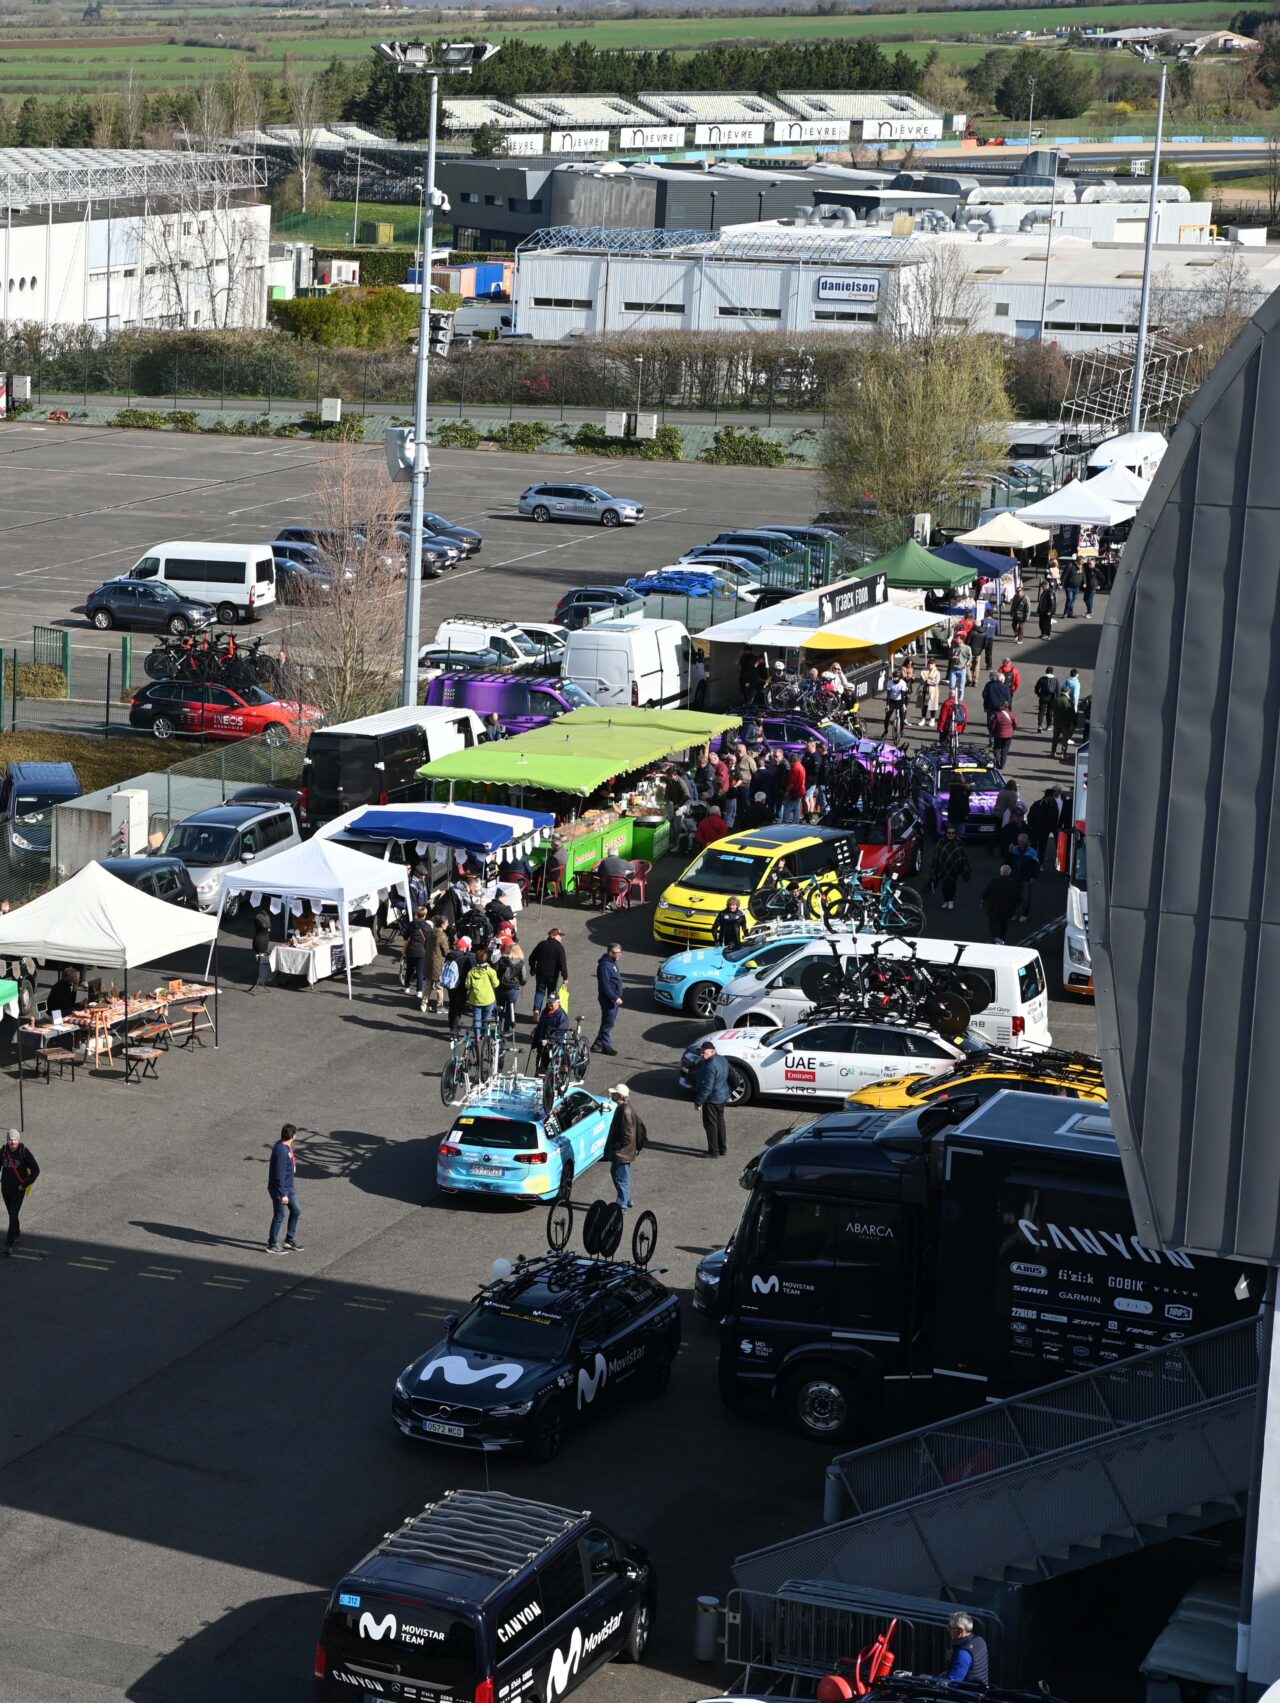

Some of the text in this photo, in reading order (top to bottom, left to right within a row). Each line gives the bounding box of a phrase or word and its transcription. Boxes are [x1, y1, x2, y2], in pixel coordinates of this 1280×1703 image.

[821, 280, 875, 293] danielson
[213, 714, 244, 726] INEOS
[784, 1056, 816, 1070] UAE
[785, 1085, 817, 1094] XRG
[845, 1222, 894, 1238] ABARCA
[1018, 1219, 1196, 1269] CANYON
[783, 1282, 815, 1291] MOVISTAR
[783, 1287, 801, 1295] TEAM
[1108, 1276, 1144, 1292] GOBIK
[1059, 1291, 1101, 1304] GARMIN
[608, 1344, 646, 1377] Movistar
[426, 1422, 446, 1433] 0572
[497, 1601, 542, 1643] CANYON
[401, 1633, 425, 1646] TEAM
[402, 1624, 445, 1641] MOVISTAR
[583, 1611, 624, 1658] Movistar
[332, 1670, 384, 1692] CANYON
